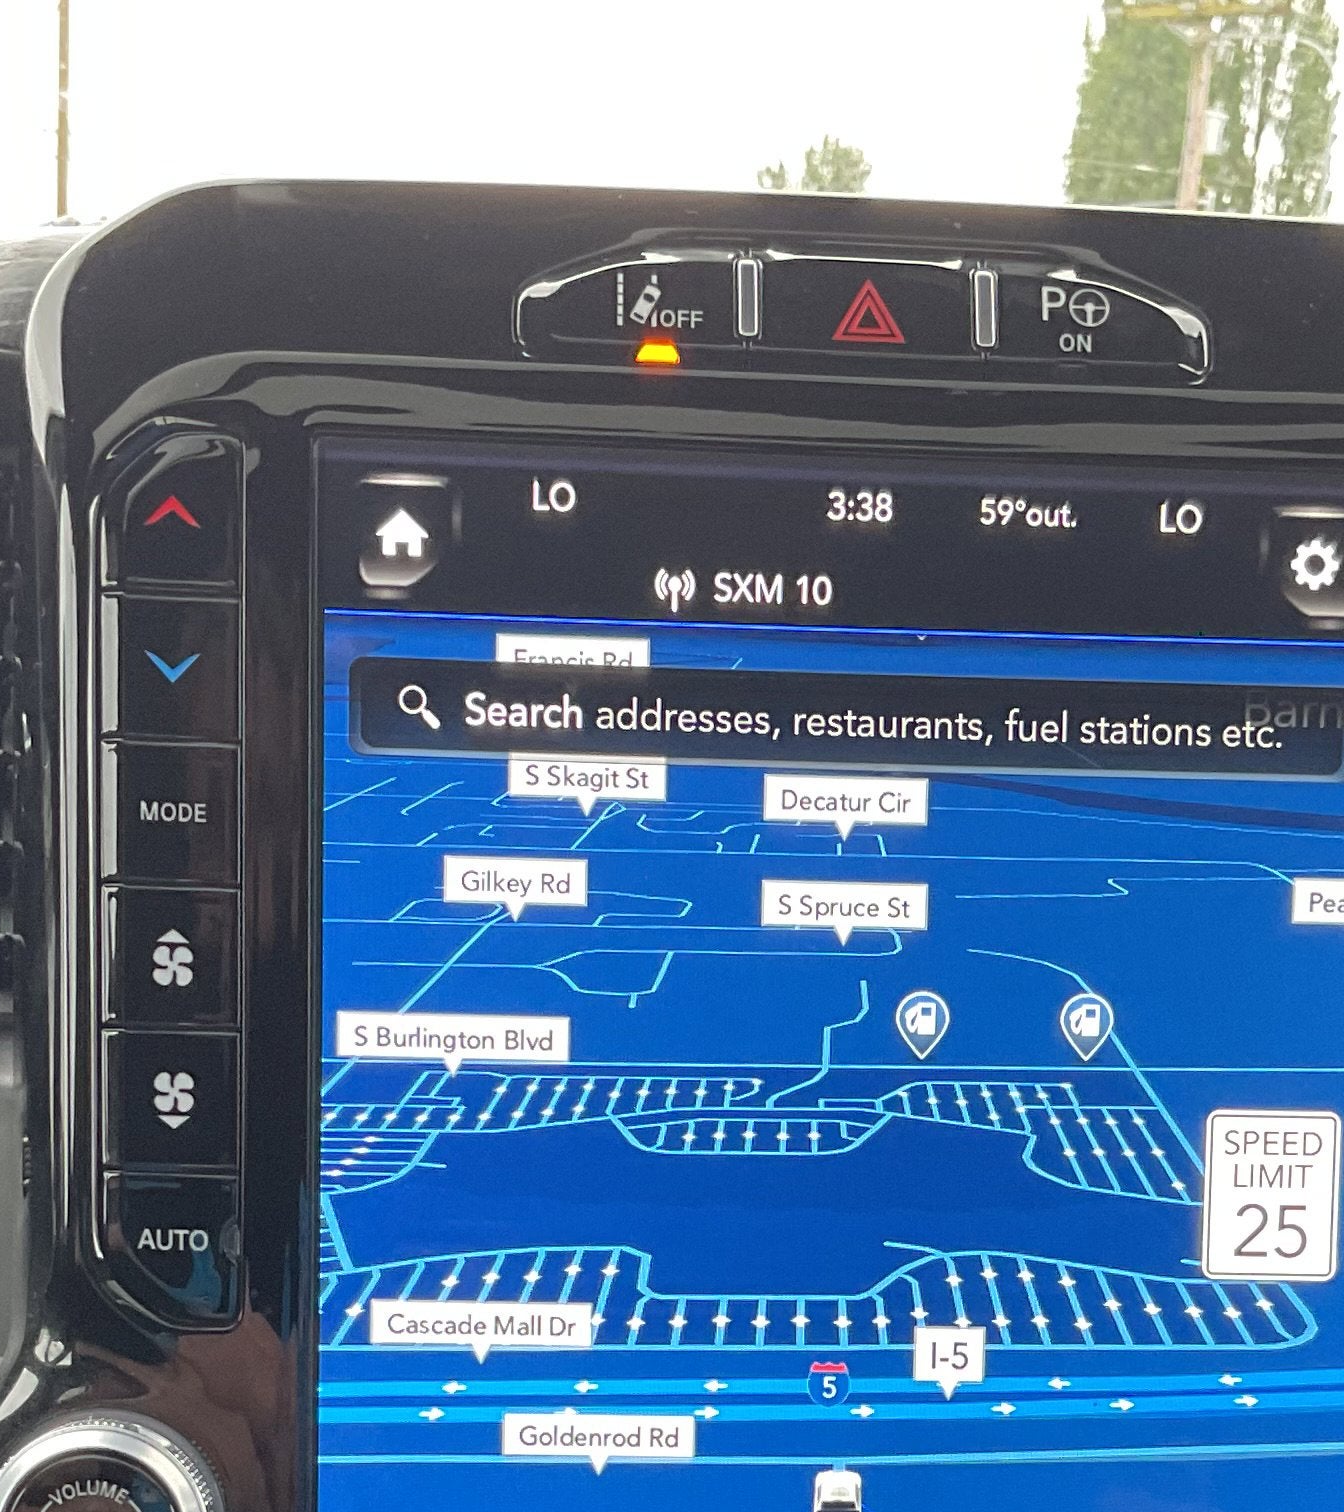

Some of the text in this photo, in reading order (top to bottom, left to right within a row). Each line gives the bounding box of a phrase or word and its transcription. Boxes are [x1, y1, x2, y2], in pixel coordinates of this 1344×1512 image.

[660, 308, 704, 329] OFF
[1059, 332, 1093, 353] ON
[532, 476, 577, 513] LO
[826, 490, 893, 523] 3:38
[1159, 501, 1203, 535] LO
[713, 572, 833, 606] SXM 10
[603, 651, 633, 670] Rd
[464, 691, 1284, 750] Search addresses, restaurants, fuel stations etc.
[525, 765, 649, 791] S Skagit St
[139, 802, 207, 823] MODE
[781, 789, 912, 814] Decatur Cir
[461, 869, 571, 900] Gilkey Rd
[778, 894, 910, 922] S Spruce St
[354, 1027, 553, 1057] S Burlington Blvd
[1223, 1130, 1323, 1157] SPEED
[1232, 1164, 1313, 1190] LIMIT
[137, 1229, 210, 1252] AUTO
[1233, 1204, 1309, 1259] 25
[388, 1315, 575, 1337] Cascade Mall Dr
[931, 1342, 969, 1369] I-5
[822, 1377, 836, 1399] 5
[519, 1425, 679, 1448] Goldenrod Rd
[48, 1480, 129, 1505] VOLUME
